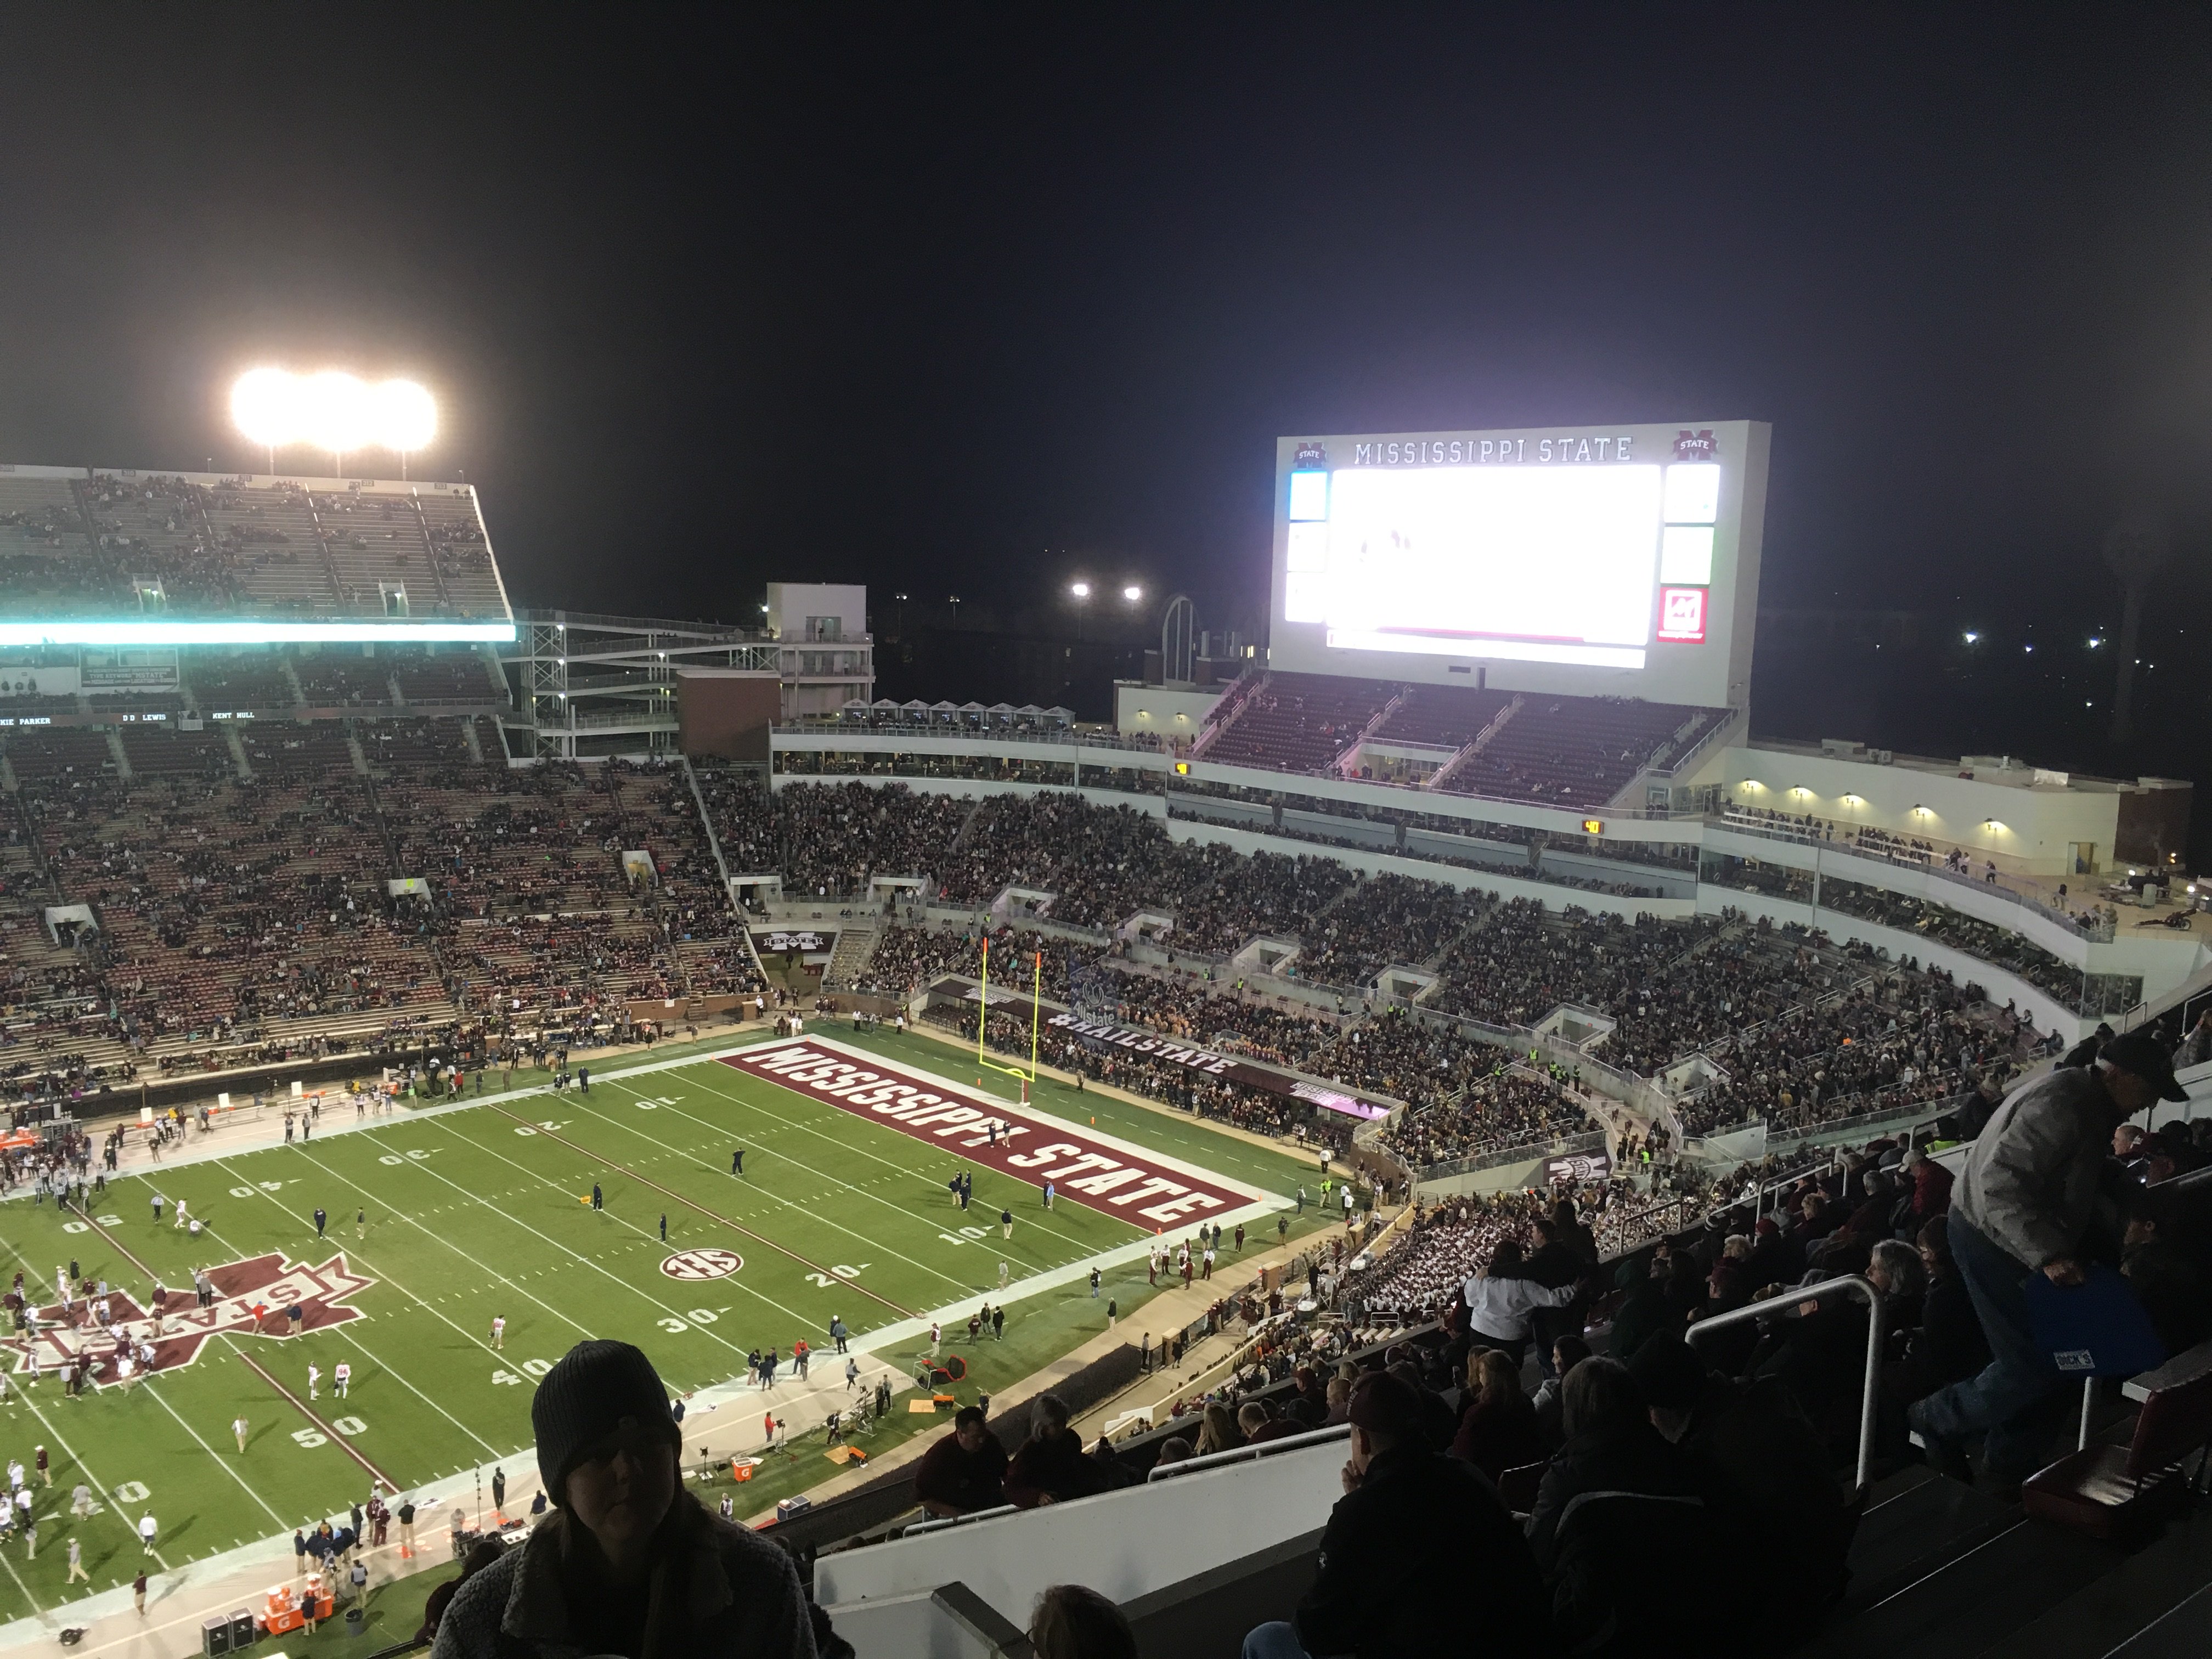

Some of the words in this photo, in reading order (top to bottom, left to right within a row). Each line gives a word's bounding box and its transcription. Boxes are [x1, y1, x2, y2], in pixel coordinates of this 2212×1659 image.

[1299, 450, 1319, 459] STATE
[1354, 439, 1526, 465] MISSISSIPPI
[1539, 437, 1633, 462] STATE
[1680, 439, 1709, 450] STATE
[1585, 821, 1599, 833] 40
[1072, 1001, 1115, 1027] Allstate
[1047, 1013, 1238, 1074] #HAILSTATE
[1291, 1082, 1357, 1104] MISSISSIPPI
[742, 1046, 1031, 1147] MISSISSIPPI
[1007, 1143, 1226, 1223] STATE
[938, 1227, 987, 1245] 10
[666, 1251, 738, 1278] SEC
[805, 1264, 861, 1288] 20
[657, 1309, 719, 1333] 30
[2056, 1353, 2092, 1366] DICKS
[492, 1358, 554, 1386] 40
[290, 1417, 368, 1448] 50
[741, 1468, 750, 1477] G
[278, 1615, 290, 1629] G
